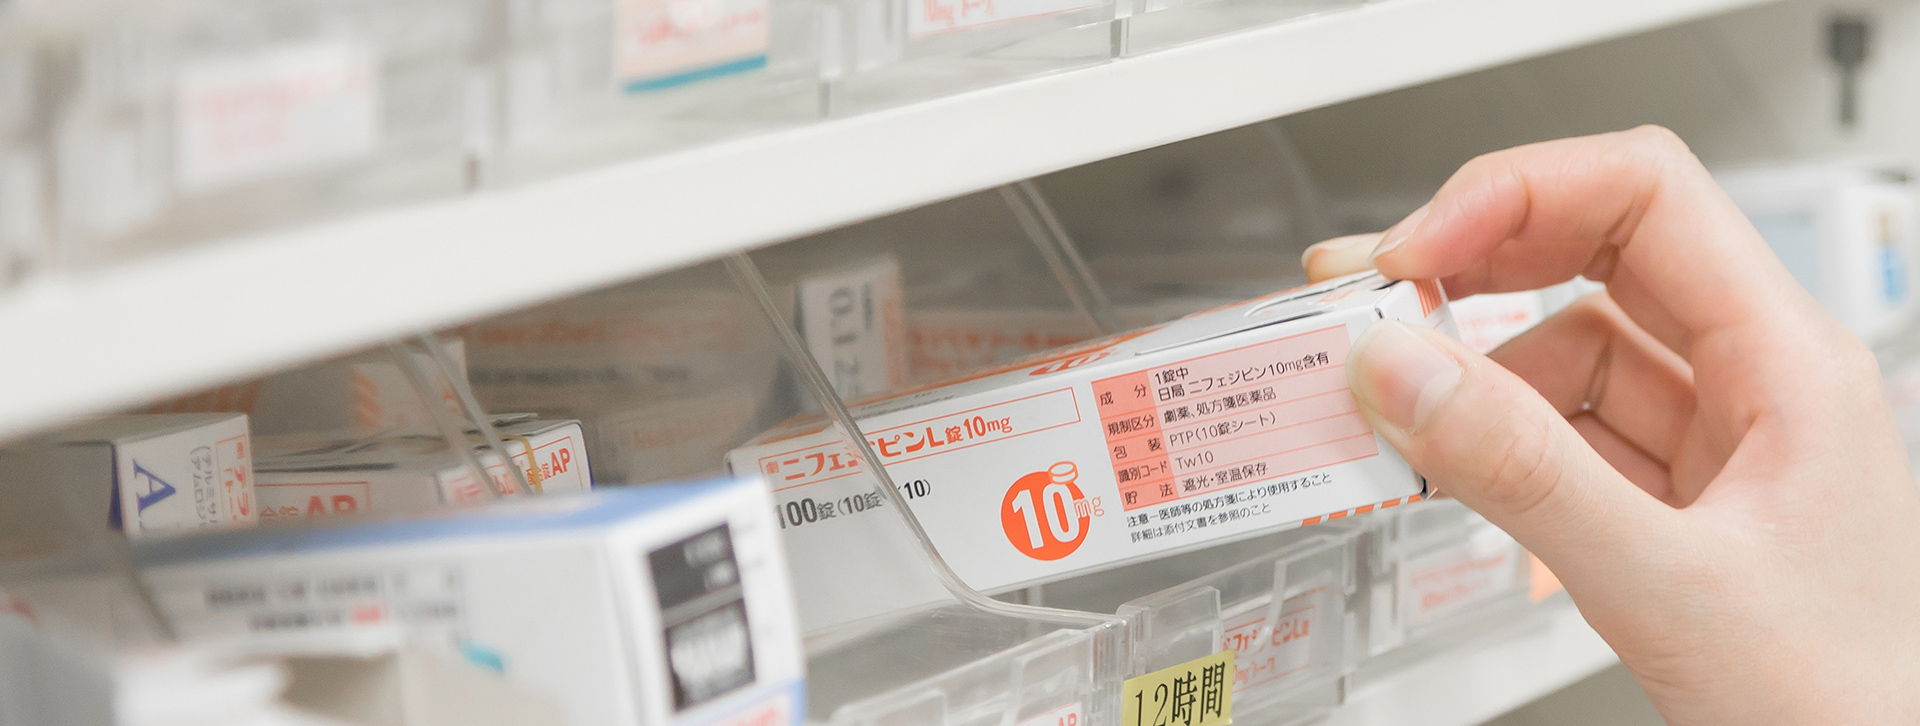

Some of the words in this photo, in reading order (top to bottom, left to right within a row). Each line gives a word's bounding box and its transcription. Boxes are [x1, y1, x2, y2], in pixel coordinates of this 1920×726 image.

[1155, 367, 1189, 385] 1錠中
[1108, 414, 1155, 436] 規制区分
[1175, 450, 1214, 470] Tw10
[1118, 460, 1168, 483] 識別コード
[775, 478, 932, 529] 100錠(10錠10)
[1135, 661, 1226, 726] 12時間
